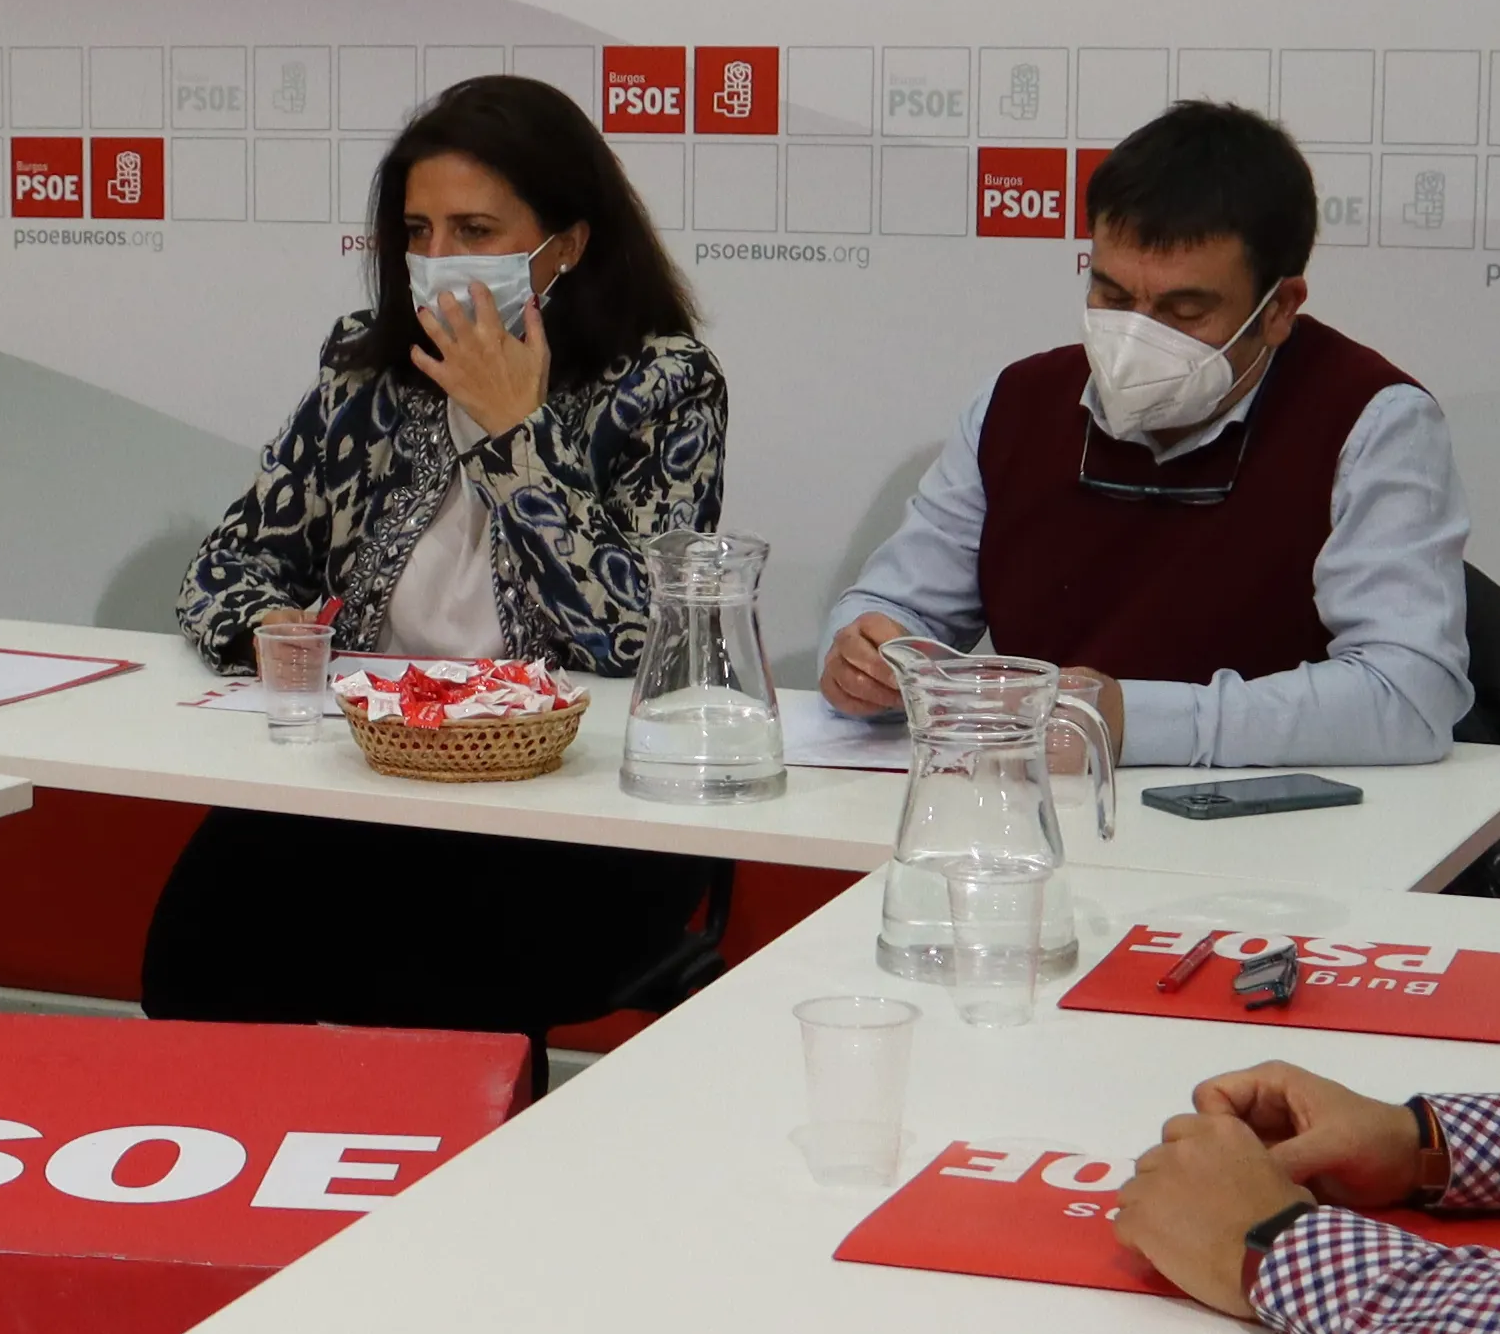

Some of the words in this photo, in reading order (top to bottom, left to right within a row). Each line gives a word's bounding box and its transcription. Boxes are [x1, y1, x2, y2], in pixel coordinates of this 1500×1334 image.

[609, 71, 646, 85] Burgos
[177, 85, 242, 112] PSOE
[608, 86, 680, 115] PSOE
[888, 89, 964, 118] PSOE
[16, 174, 80, 201] PSOE
[984, 173, 1023, 187] Burgos
[983, 188, 1060, 219] PSOE
[14, 228, 163, 252] psoeBURGOS.org
[696, 242, 870, 269] psoeBURGOS.org
[1306, 970, 1439, 996] Burg
